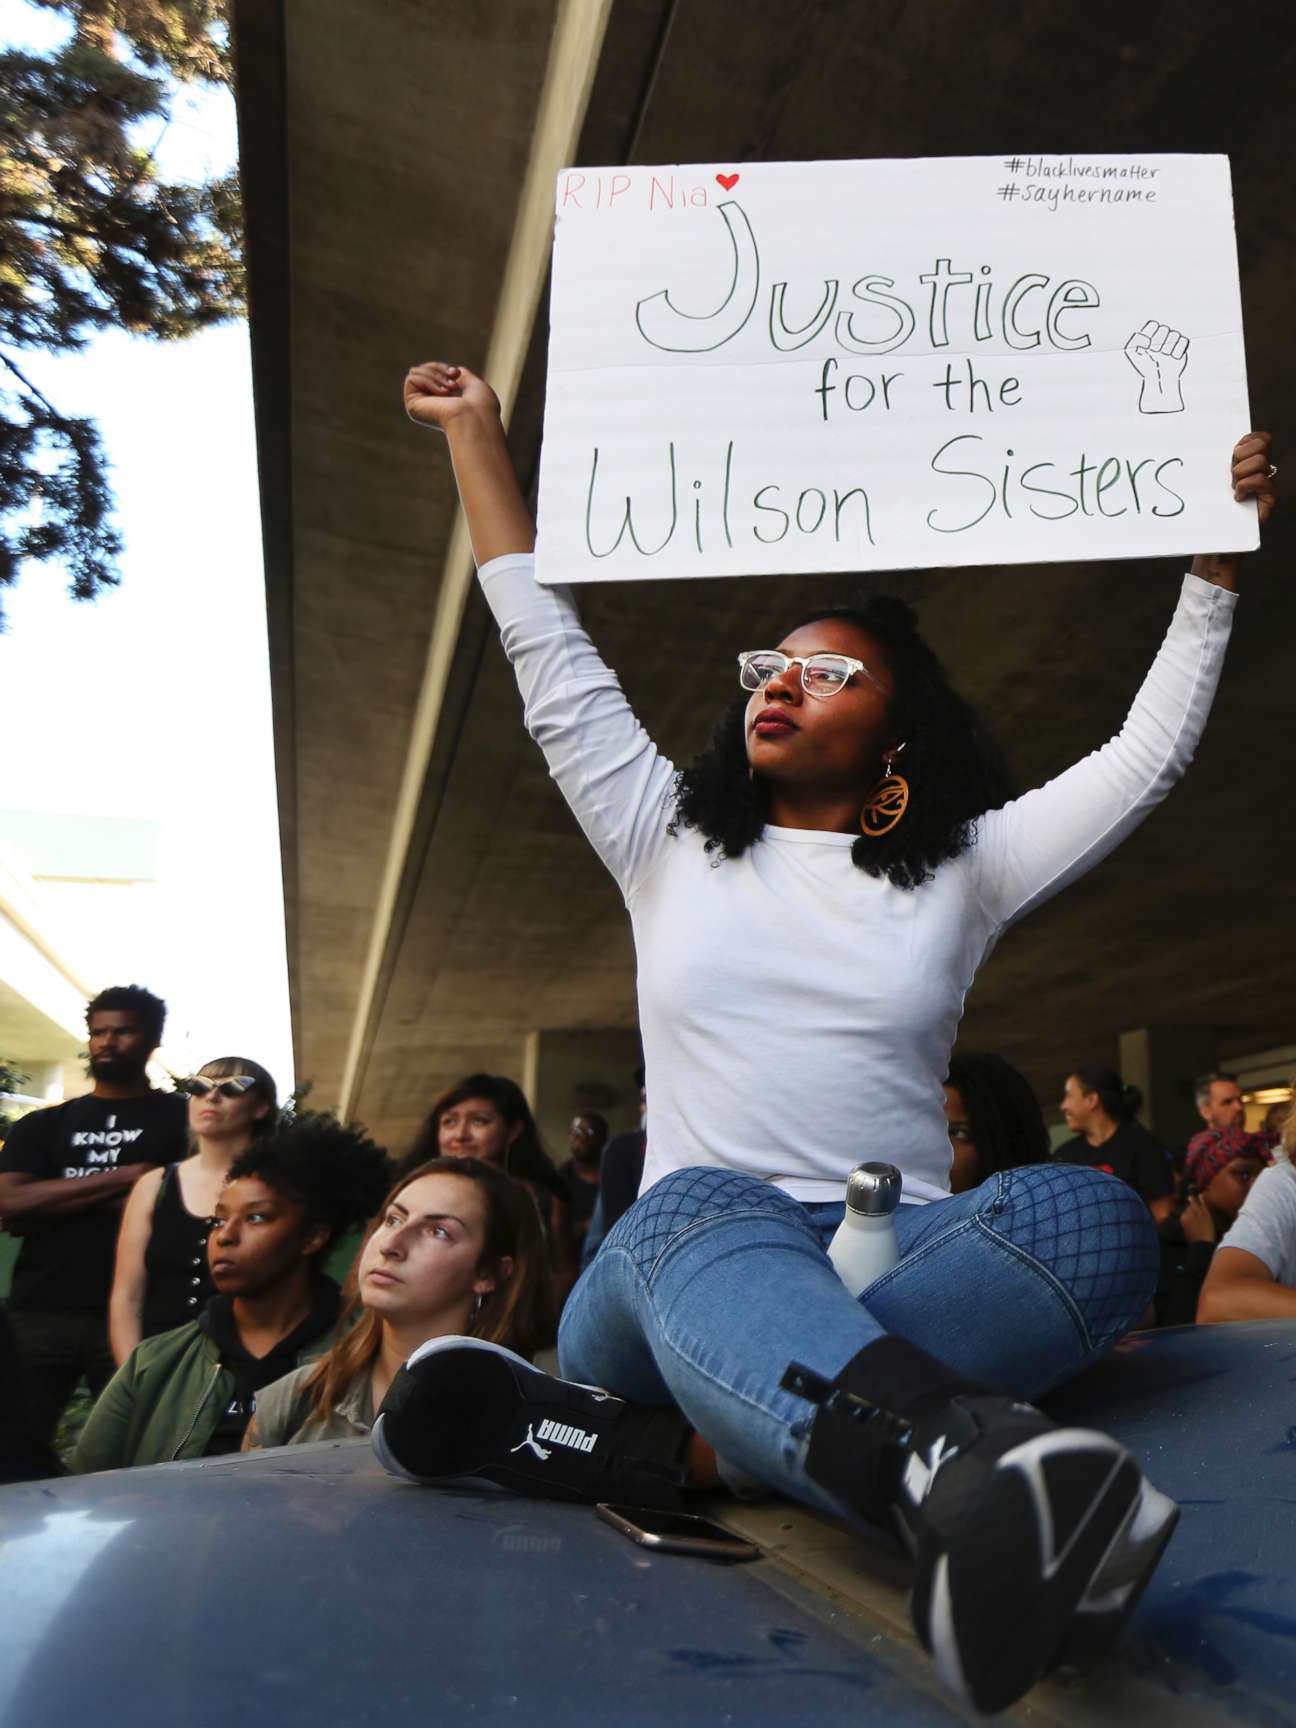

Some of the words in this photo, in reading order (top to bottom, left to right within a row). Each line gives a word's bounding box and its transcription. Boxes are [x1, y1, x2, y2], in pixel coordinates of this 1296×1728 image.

[1003, 157, 1160, 180] #blacklivesmatter
[563, 174, 631, 208] RIP
[650, 175, 707, 210] Nia
[636, 201, 1100, 355] Justice
[814, 358, 904, 421] for
[932, 359, 1022, 408] the
[585, 440, 876, 559] Wilson
[926, 434, 1186, 533] Sisters
[71, 1128, 143, 1147] KNOW
[107, 1114, 117, 1129] I
[87, 1148, 121, 1163] MY
[536, 1418, 599, 1453] PUMA
